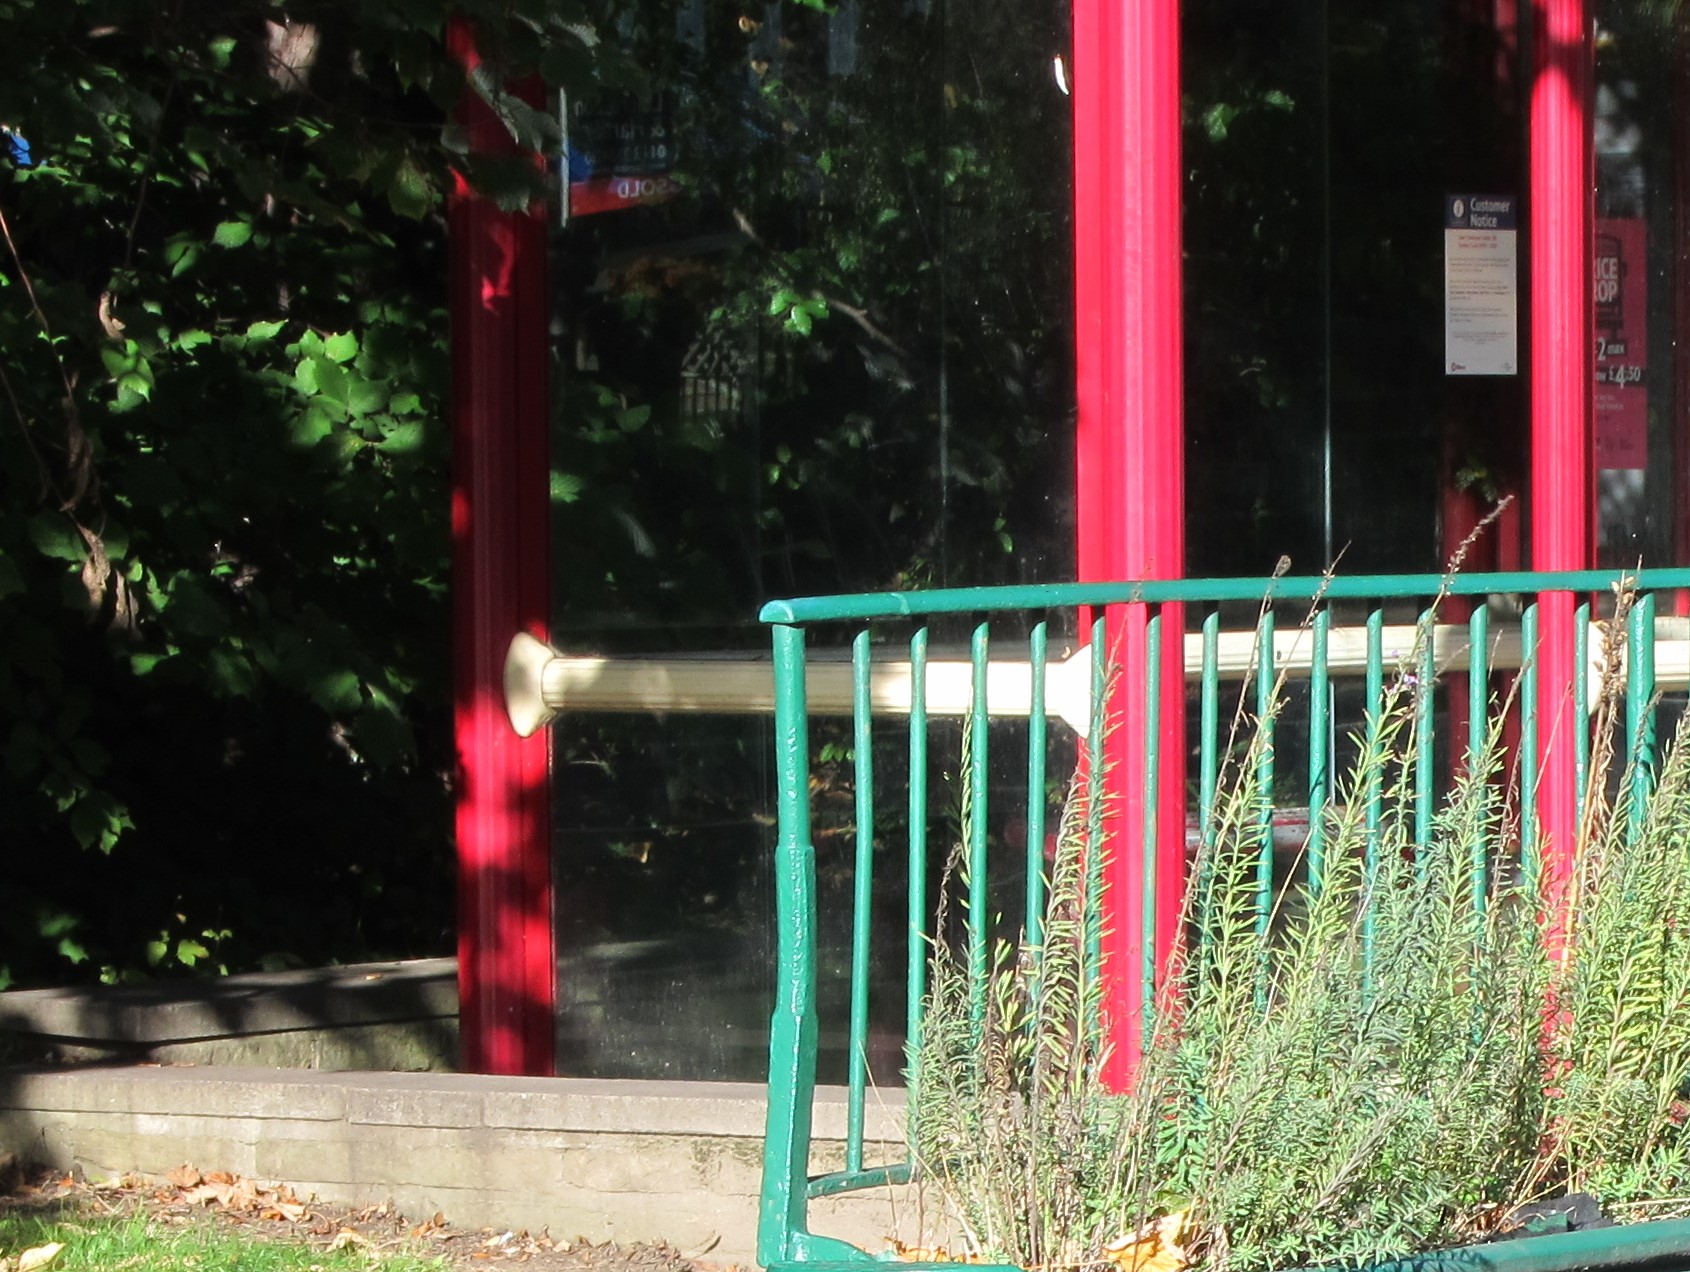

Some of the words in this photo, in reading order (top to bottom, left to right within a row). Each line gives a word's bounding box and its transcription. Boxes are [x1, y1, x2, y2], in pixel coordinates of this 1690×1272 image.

[1470, 197, 1510, 213] Customer
[1470, 213, 1498, 228] Notice
[1596, 256, 1619, 280] ICE
[1593, 280, 1619, 303] OP
